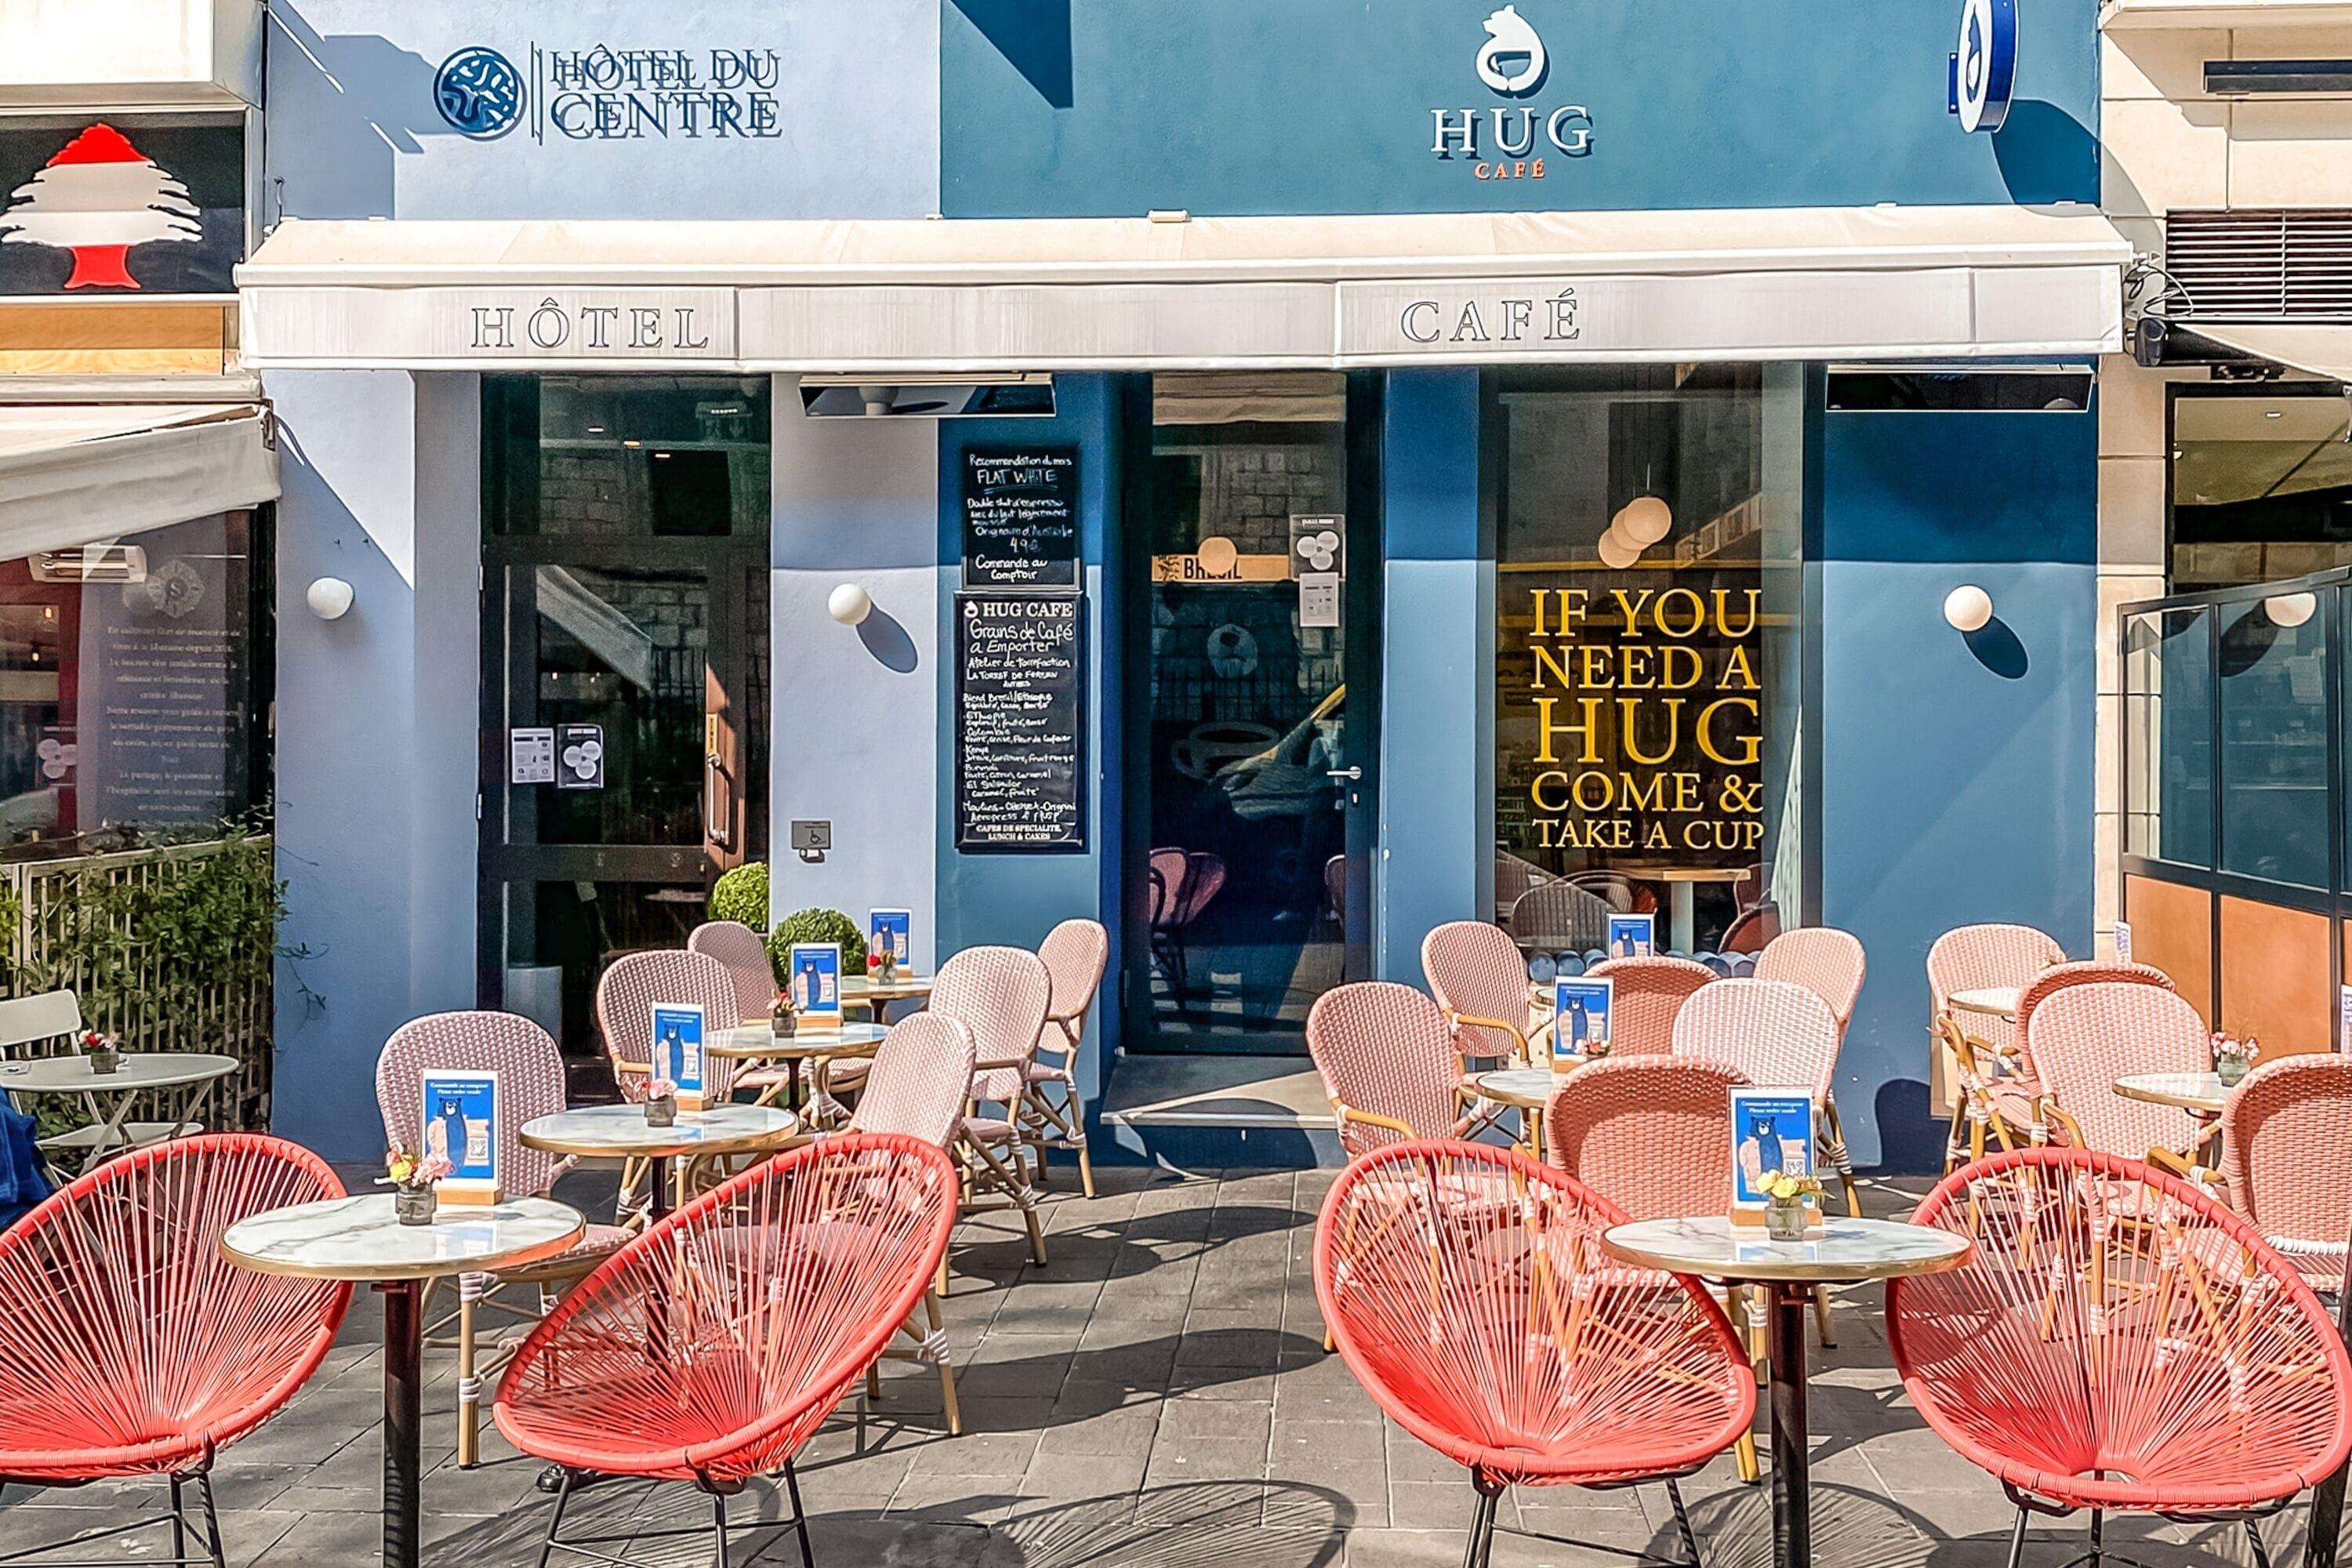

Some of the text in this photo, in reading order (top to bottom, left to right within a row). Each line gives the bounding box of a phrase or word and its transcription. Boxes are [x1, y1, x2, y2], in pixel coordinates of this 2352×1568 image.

[550, 43, 775, 82] HÔTEL DU
[550, 92, 775, 132] CENTRE
[1430, 105, 1591, 153] HUG
[1475, 158, 1545, 180] CAFÉ
[471, 296, 709, 348] HÔTEL
[1401, 288, 1580, 343] CAFÉ
[977, 467, 1058, 485] FLAT WHITE
[975, 554, 1029, 569] Commande
[982, 601, 1073, 618] HUG CAFE
[1530, 588, 1762, 637] IF YOU
[970, 618, 1073, 646] Grains de Café
[986, 639, 1055, 660] Emporter
[1530, 644, 1762, 690] NEED A
[1532, 697, 1764, 765] HUG
[1531, 771, 1764, 813] COME &
[1532, 818, 1634, 849] TAKE
[1644, 820, 1672, 849] A
[1683, 820, 1765, 850] CUP
